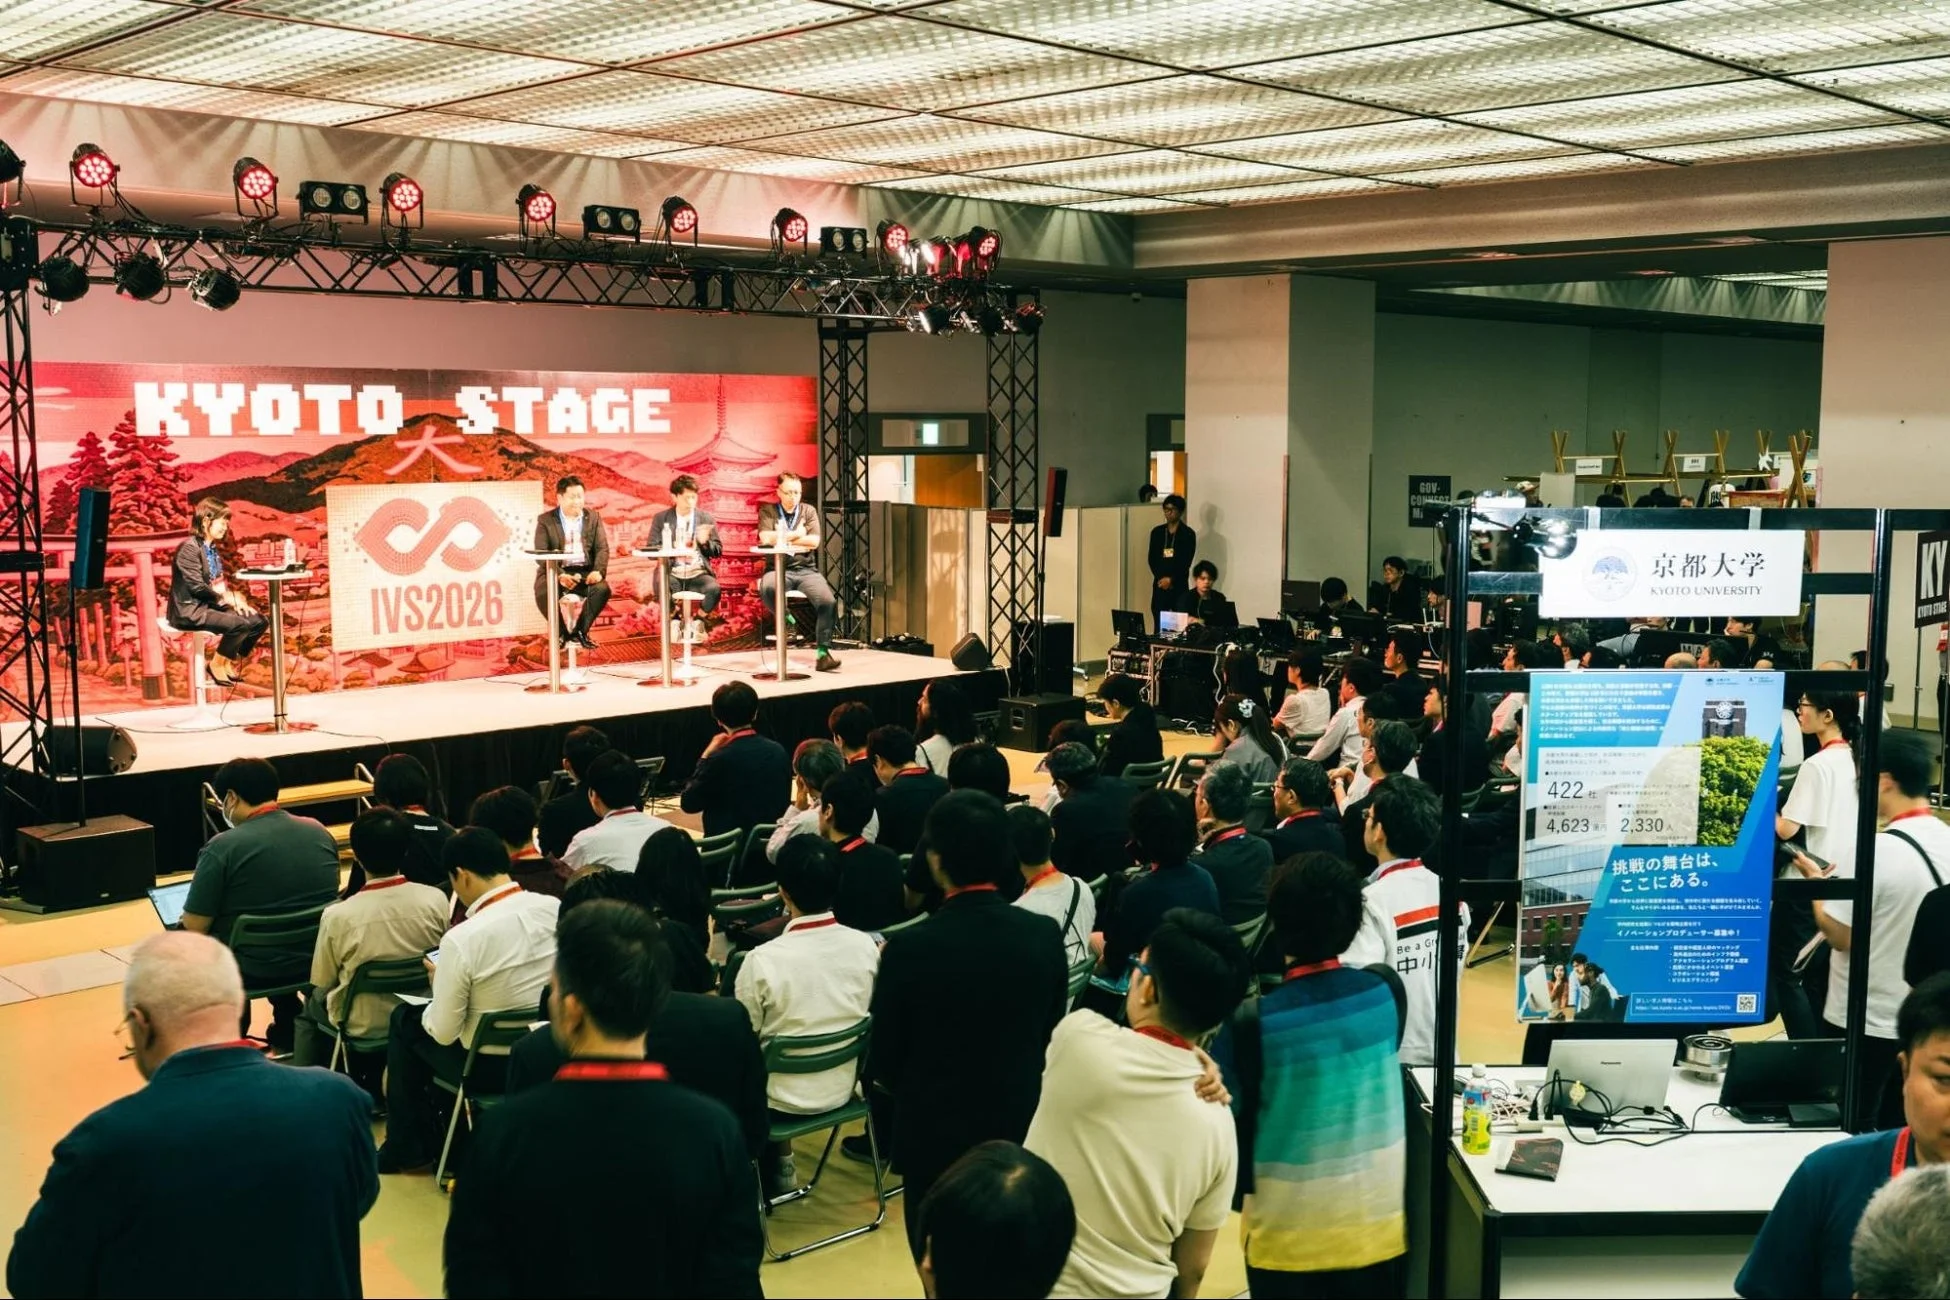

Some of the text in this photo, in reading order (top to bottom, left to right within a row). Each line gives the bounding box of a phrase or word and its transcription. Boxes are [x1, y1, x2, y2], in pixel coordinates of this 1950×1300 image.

[134, 382, 672, 437] KYOTO STAGE
[385, 424, 484, 476] 大
[1652, 552, 1765, 578] 京都大学
[1651, 585, 1762, 596] KYOTO UNIVERSITY
[371, 580, 504, 635] IVS2026
[1548, 781, 1584, 799] 422
[1547, 818, 1589, 834] 4,623
[1620, 818, 1663, 834] 2,330
[1612, 852, 1718, 876] 挑戦の舞台は、
[1621, 872, 1709, 893] ここにある。
[1397, 945, 1411, 955] Be
[1415, 943, 1421, 951] a
